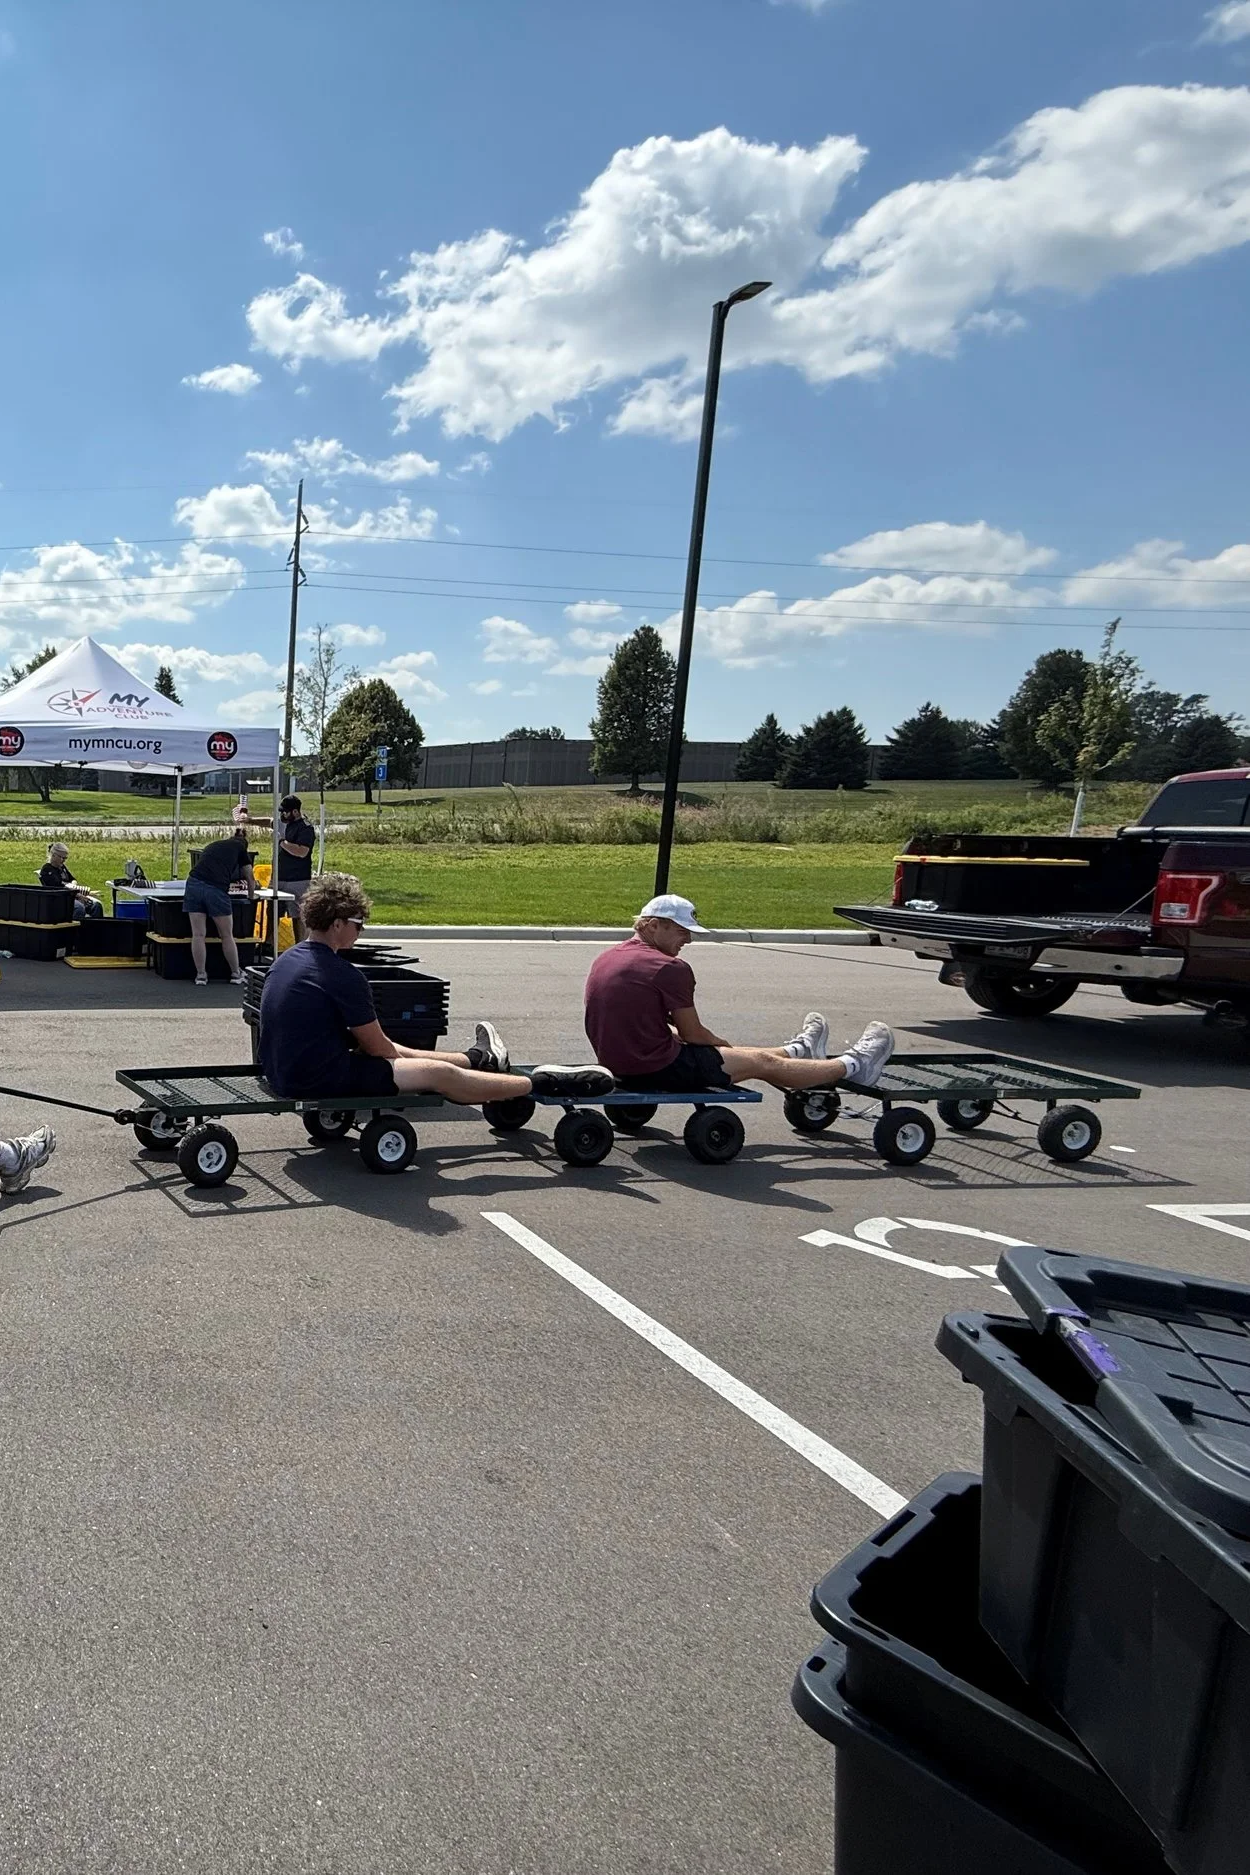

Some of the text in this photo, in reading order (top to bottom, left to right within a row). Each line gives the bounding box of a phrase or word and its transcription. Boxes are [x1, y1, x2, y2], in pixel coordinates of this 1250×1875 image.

[108, 693, 150, 707] MY
[86, 706, 174, 718] ADVENTURE
[68, 738, 162, 755] mymncu.org
[210, 741, 235, 753] my
